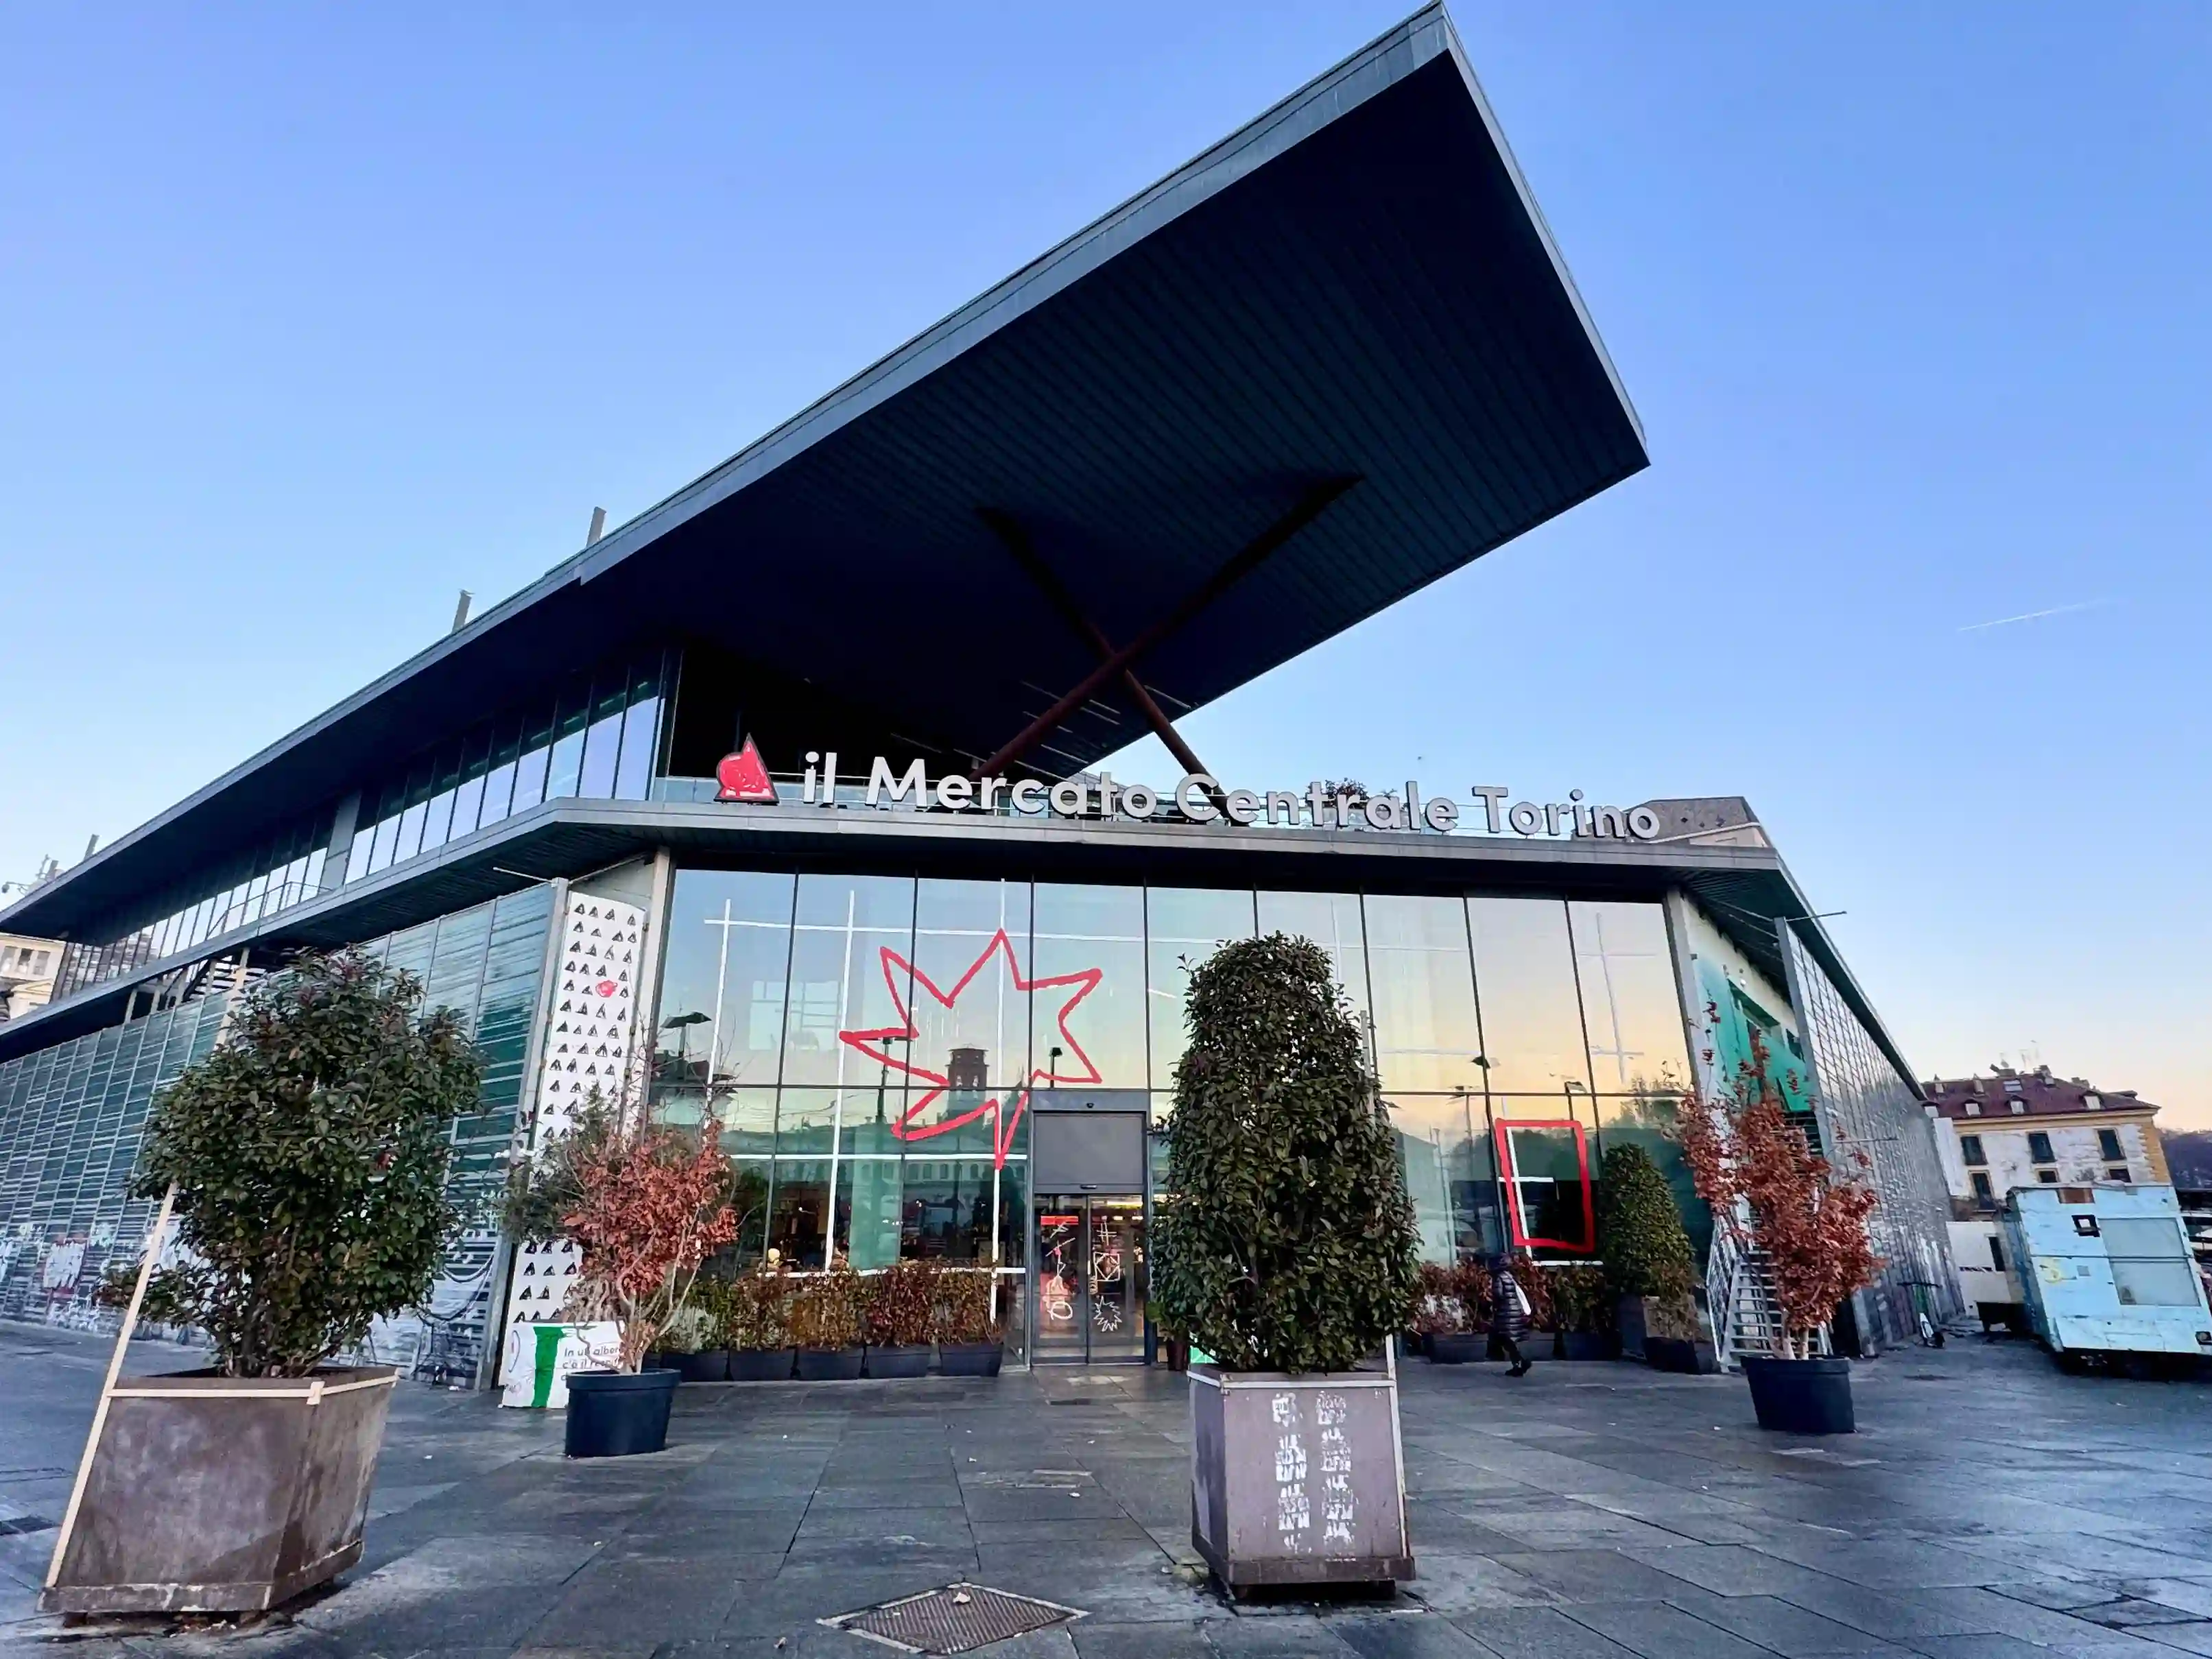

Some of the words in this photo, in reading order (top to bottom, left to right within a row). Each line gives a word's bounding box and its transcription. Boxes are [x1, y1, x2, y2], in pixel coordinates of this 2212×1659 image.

[803, 752, 837, 804] il
[865, 756, 1157, 820] Mercato
[1175, 773, 1458, 833] Centrale
[1471, 785, 1660, 839] Torino
